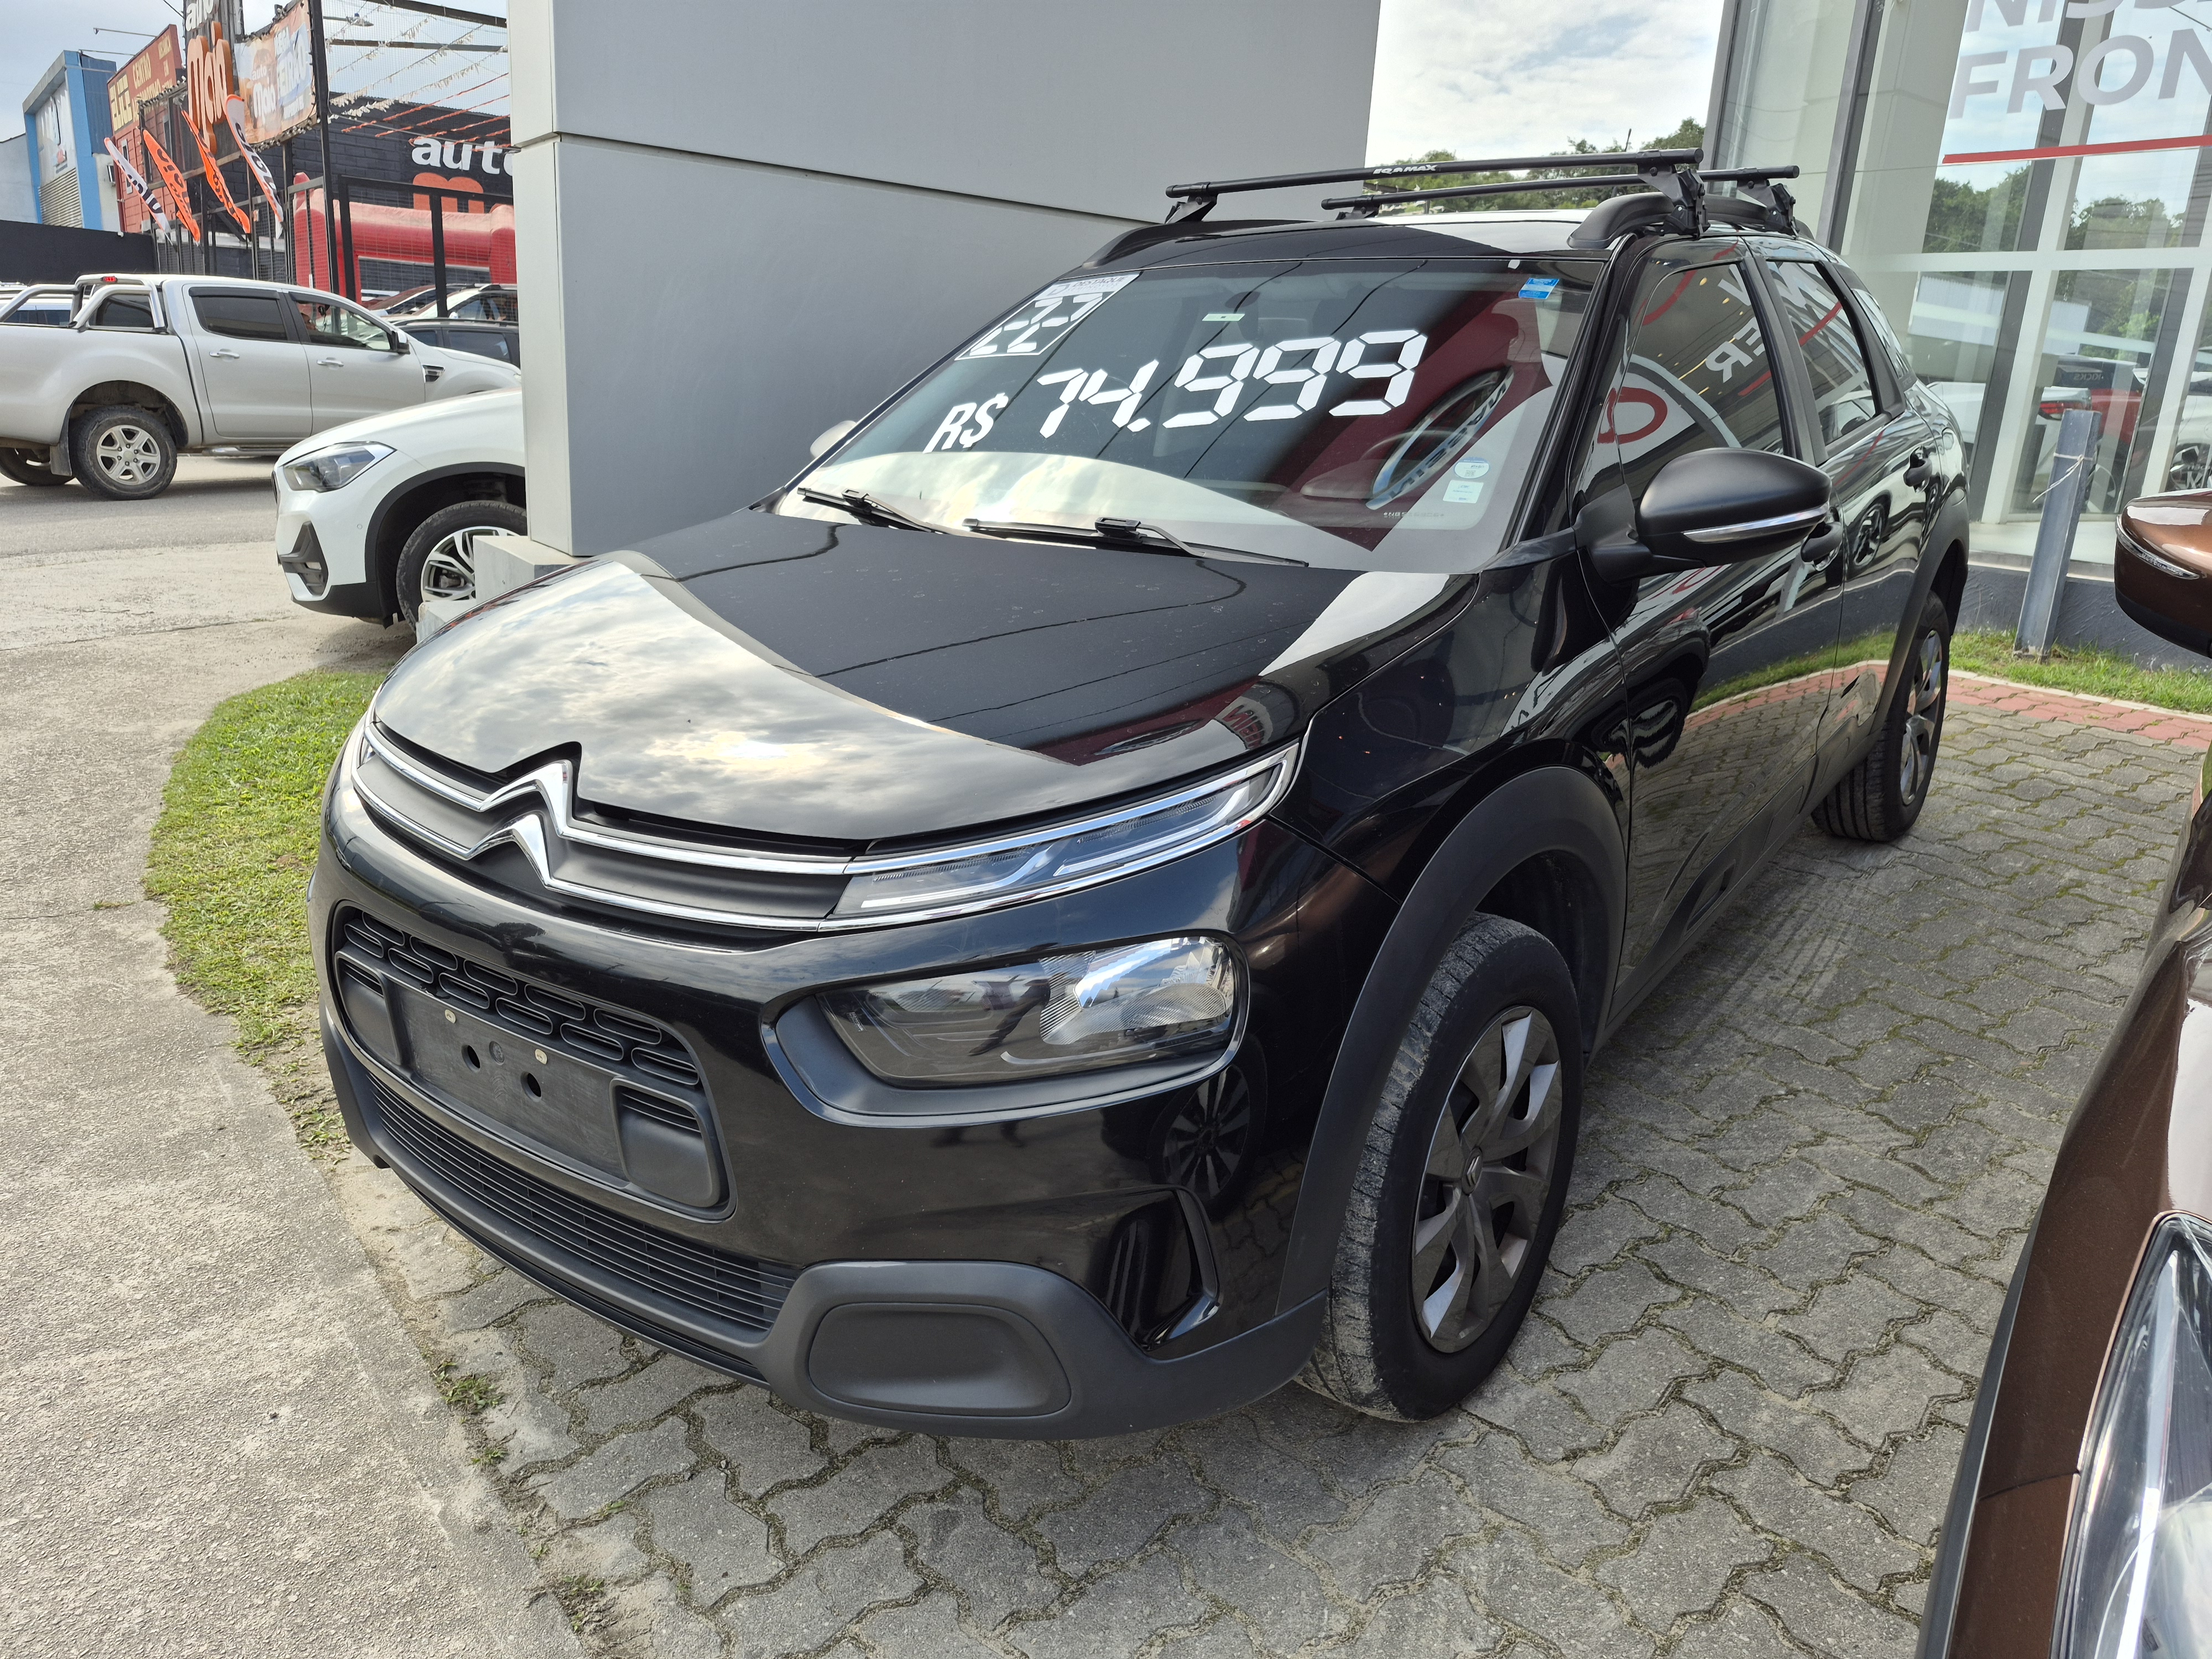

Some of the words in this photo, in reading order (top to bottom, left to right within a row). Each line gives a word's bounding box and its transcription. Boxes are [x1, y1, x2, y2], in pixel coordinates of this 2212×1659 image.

[132, 52, 152, 90] CENTRO
[1072, 276, 1129, 287] DESTAQUE
[922, 393, 1008, 453] R$
[1037, 330, 1428, 440] 74.999
